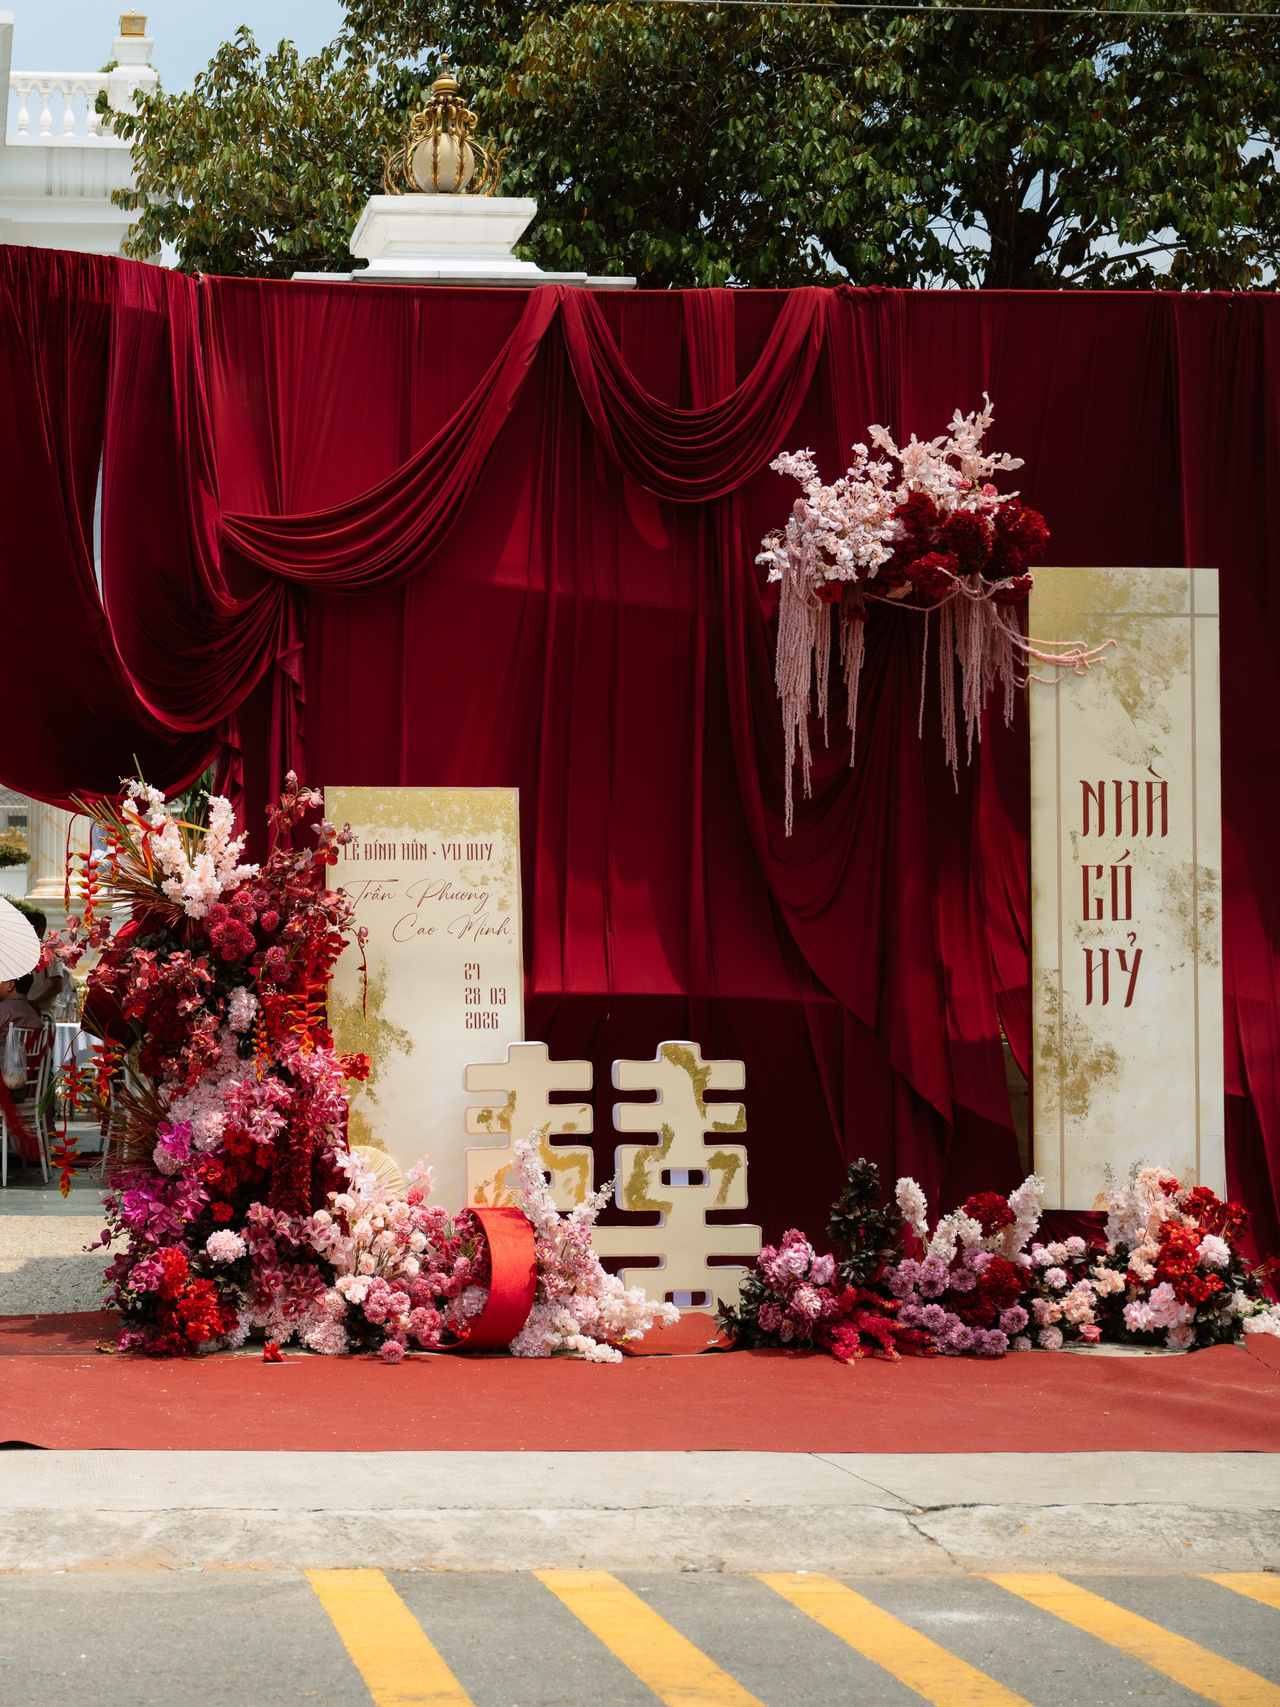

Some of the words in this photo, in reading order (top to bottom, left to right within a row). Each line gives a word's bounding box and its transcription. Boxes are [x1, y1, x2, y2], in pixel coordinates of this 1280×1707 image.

[1079, 765, 1168, 838] NHÀ
[363, 839, 396, 861] ĐÍNH
[401, 838, 428, 861] HÔN
[441, 843, 461, 861] VU
[342, 878, 399, 909] Trần
[392, 912, 438, 943] Cao
[447, 912, 512, 942] Minh
[464, 987, 481, 1006] 28
[490, 987, 507, 1006] 03
[465, 1011, 499, 1030] 2026
